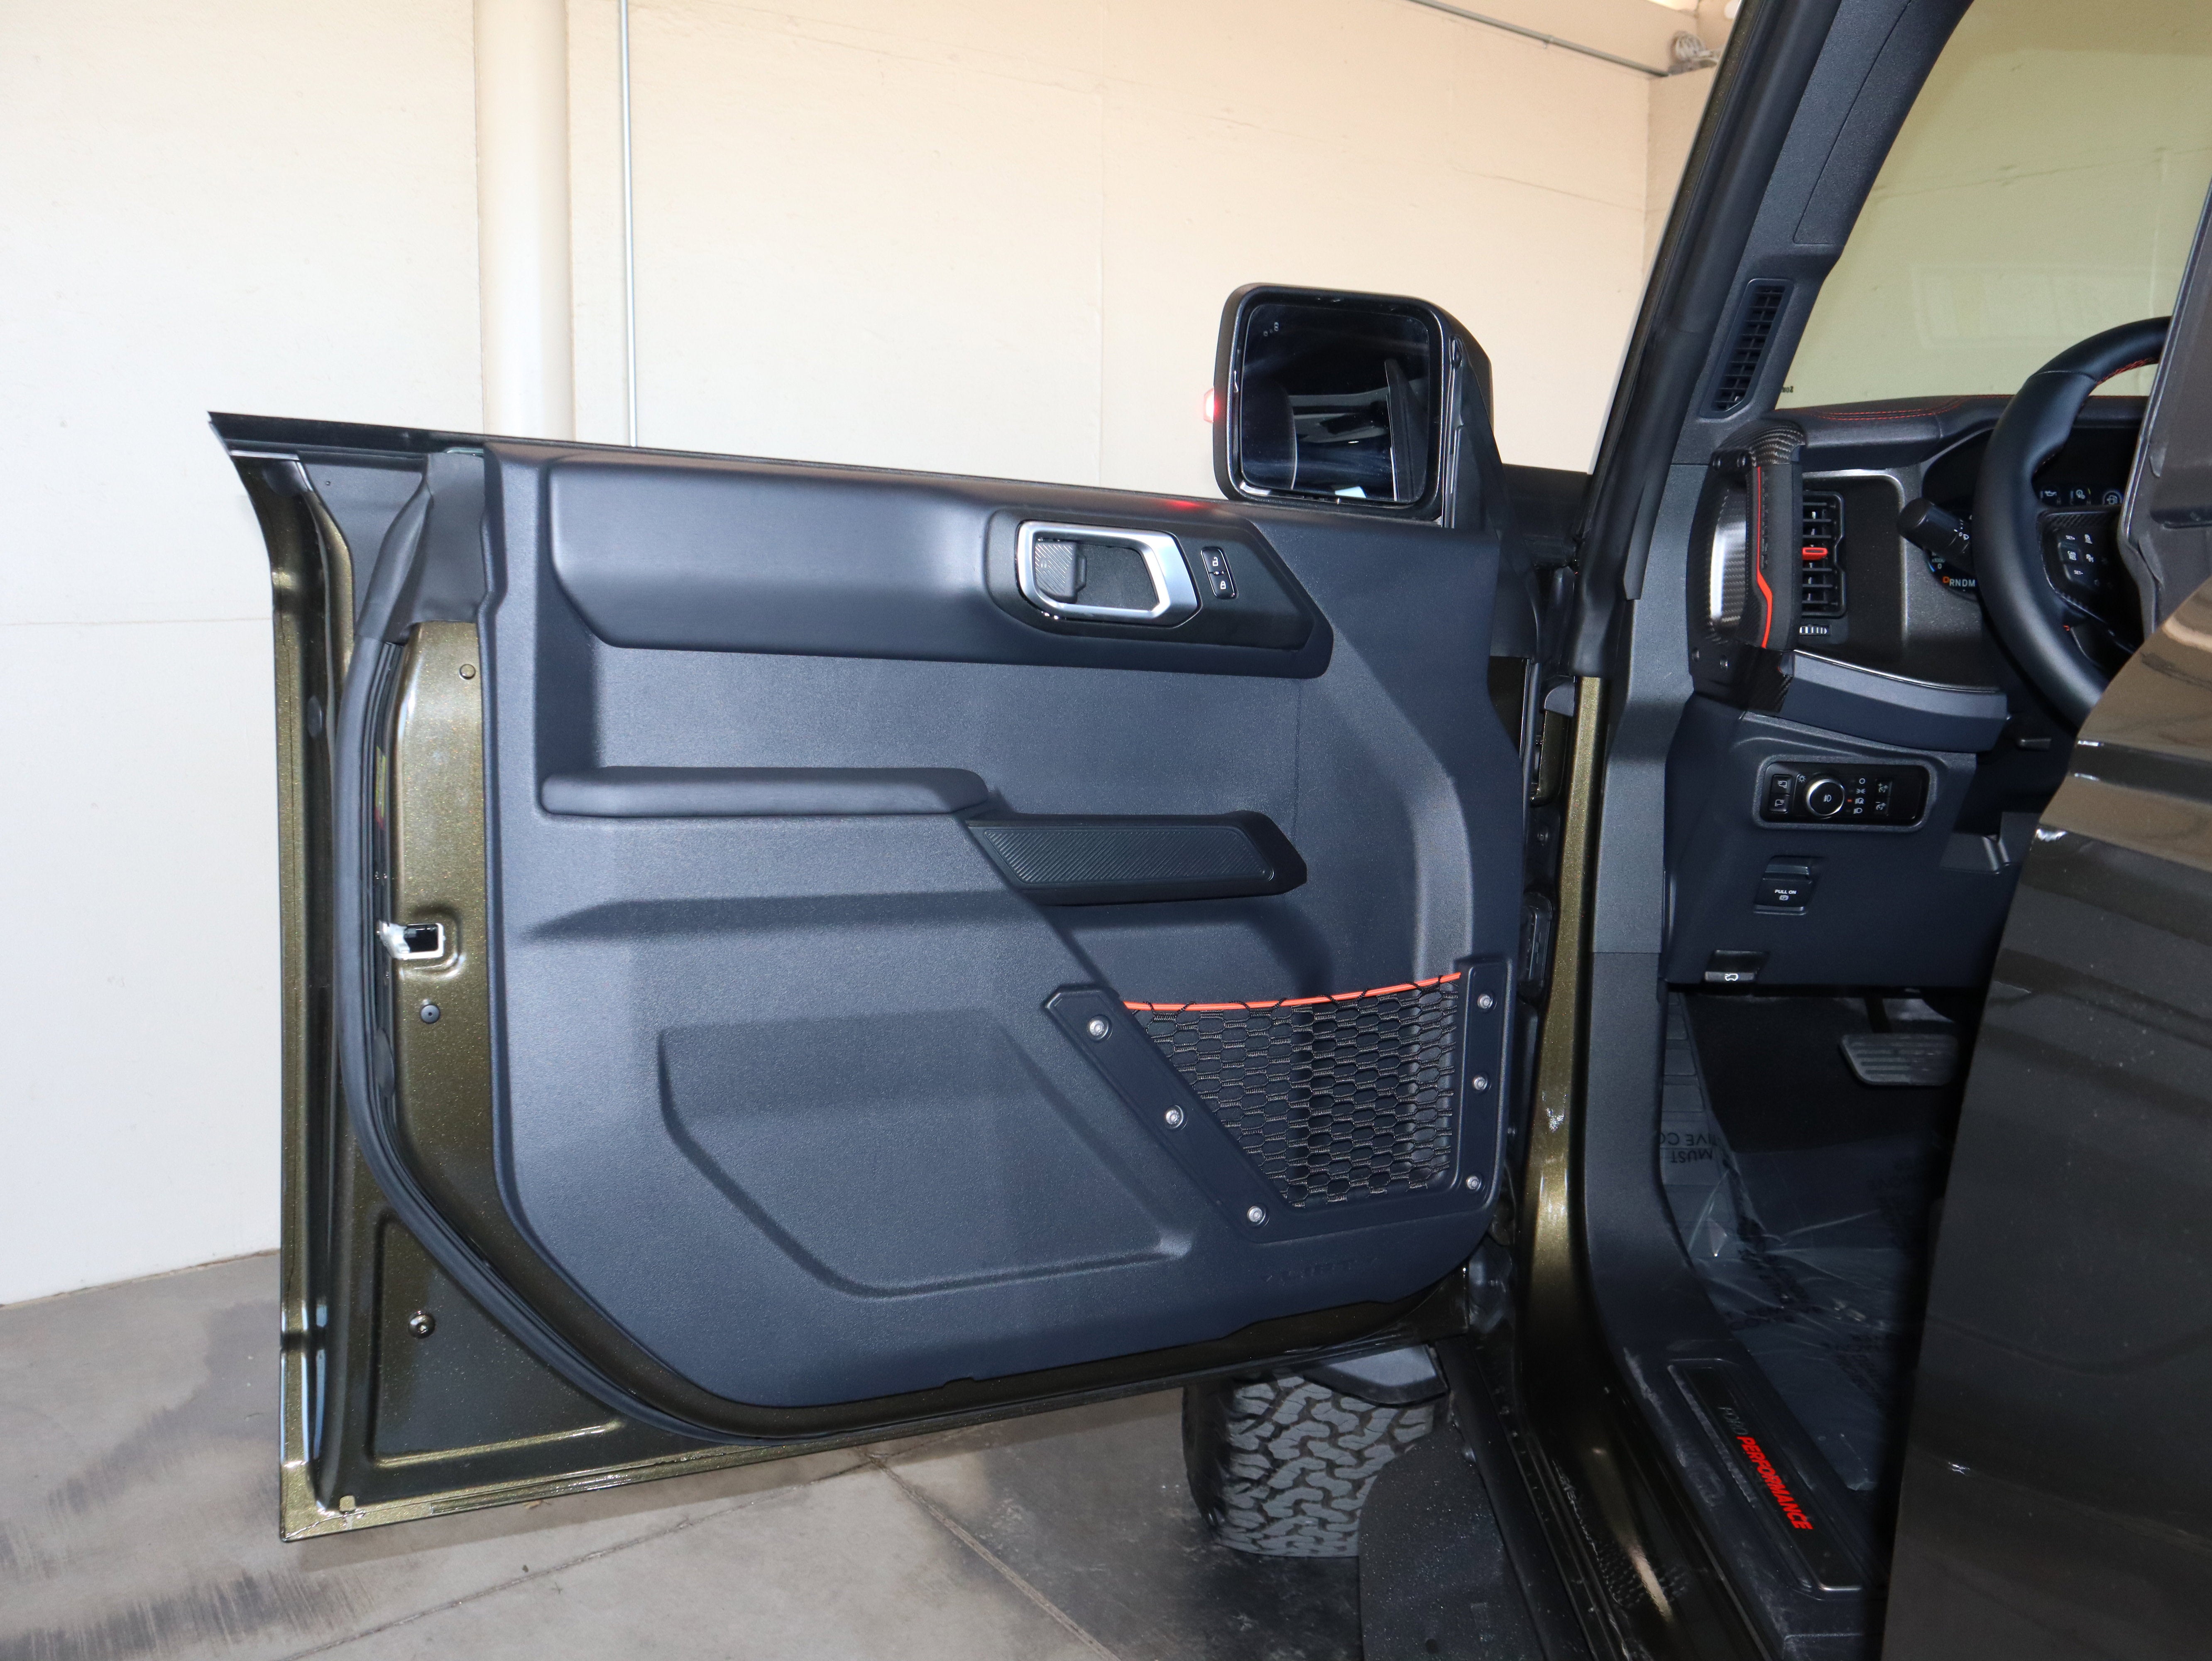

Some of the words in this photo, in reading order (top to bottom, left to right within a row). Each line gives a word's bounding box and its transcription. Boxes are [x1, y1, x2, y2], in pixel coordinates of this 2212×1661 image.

[1670, 1149, 1713, 1163] MUST
[1718, 1406, 1749, 1435] FORD
[1736, 1435, 1814, 1530] PERFORMANCE
